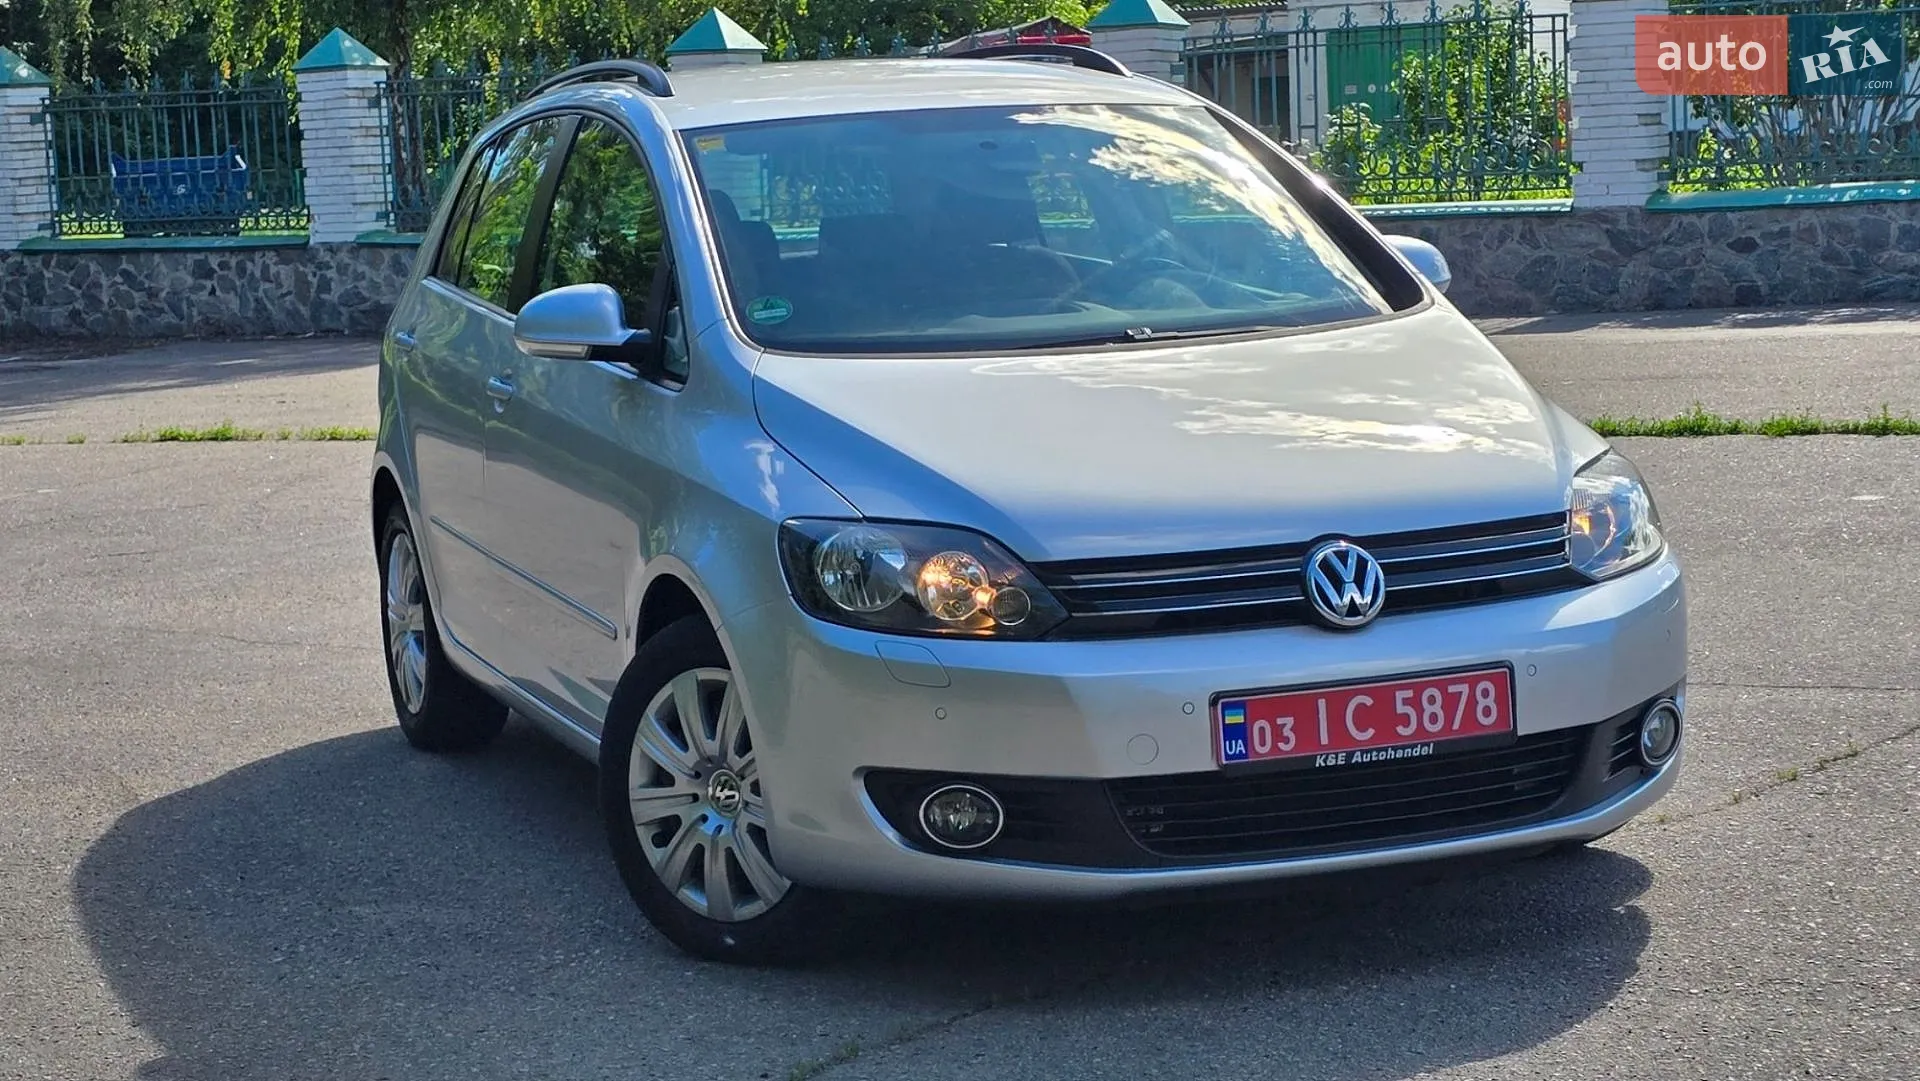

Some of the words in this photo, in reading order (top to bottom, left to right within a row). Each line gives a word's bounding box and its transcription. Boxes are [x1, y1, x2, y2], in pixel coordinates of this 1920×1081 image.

[1252, 716, 1297, 754] 03
[1395, 680, 1499, 737] 5878
[1225, 739, 1247, 756] UA
[1315, 752, 1347, 768] K&E
[1351, 742, 1435, 764] Autohandel
